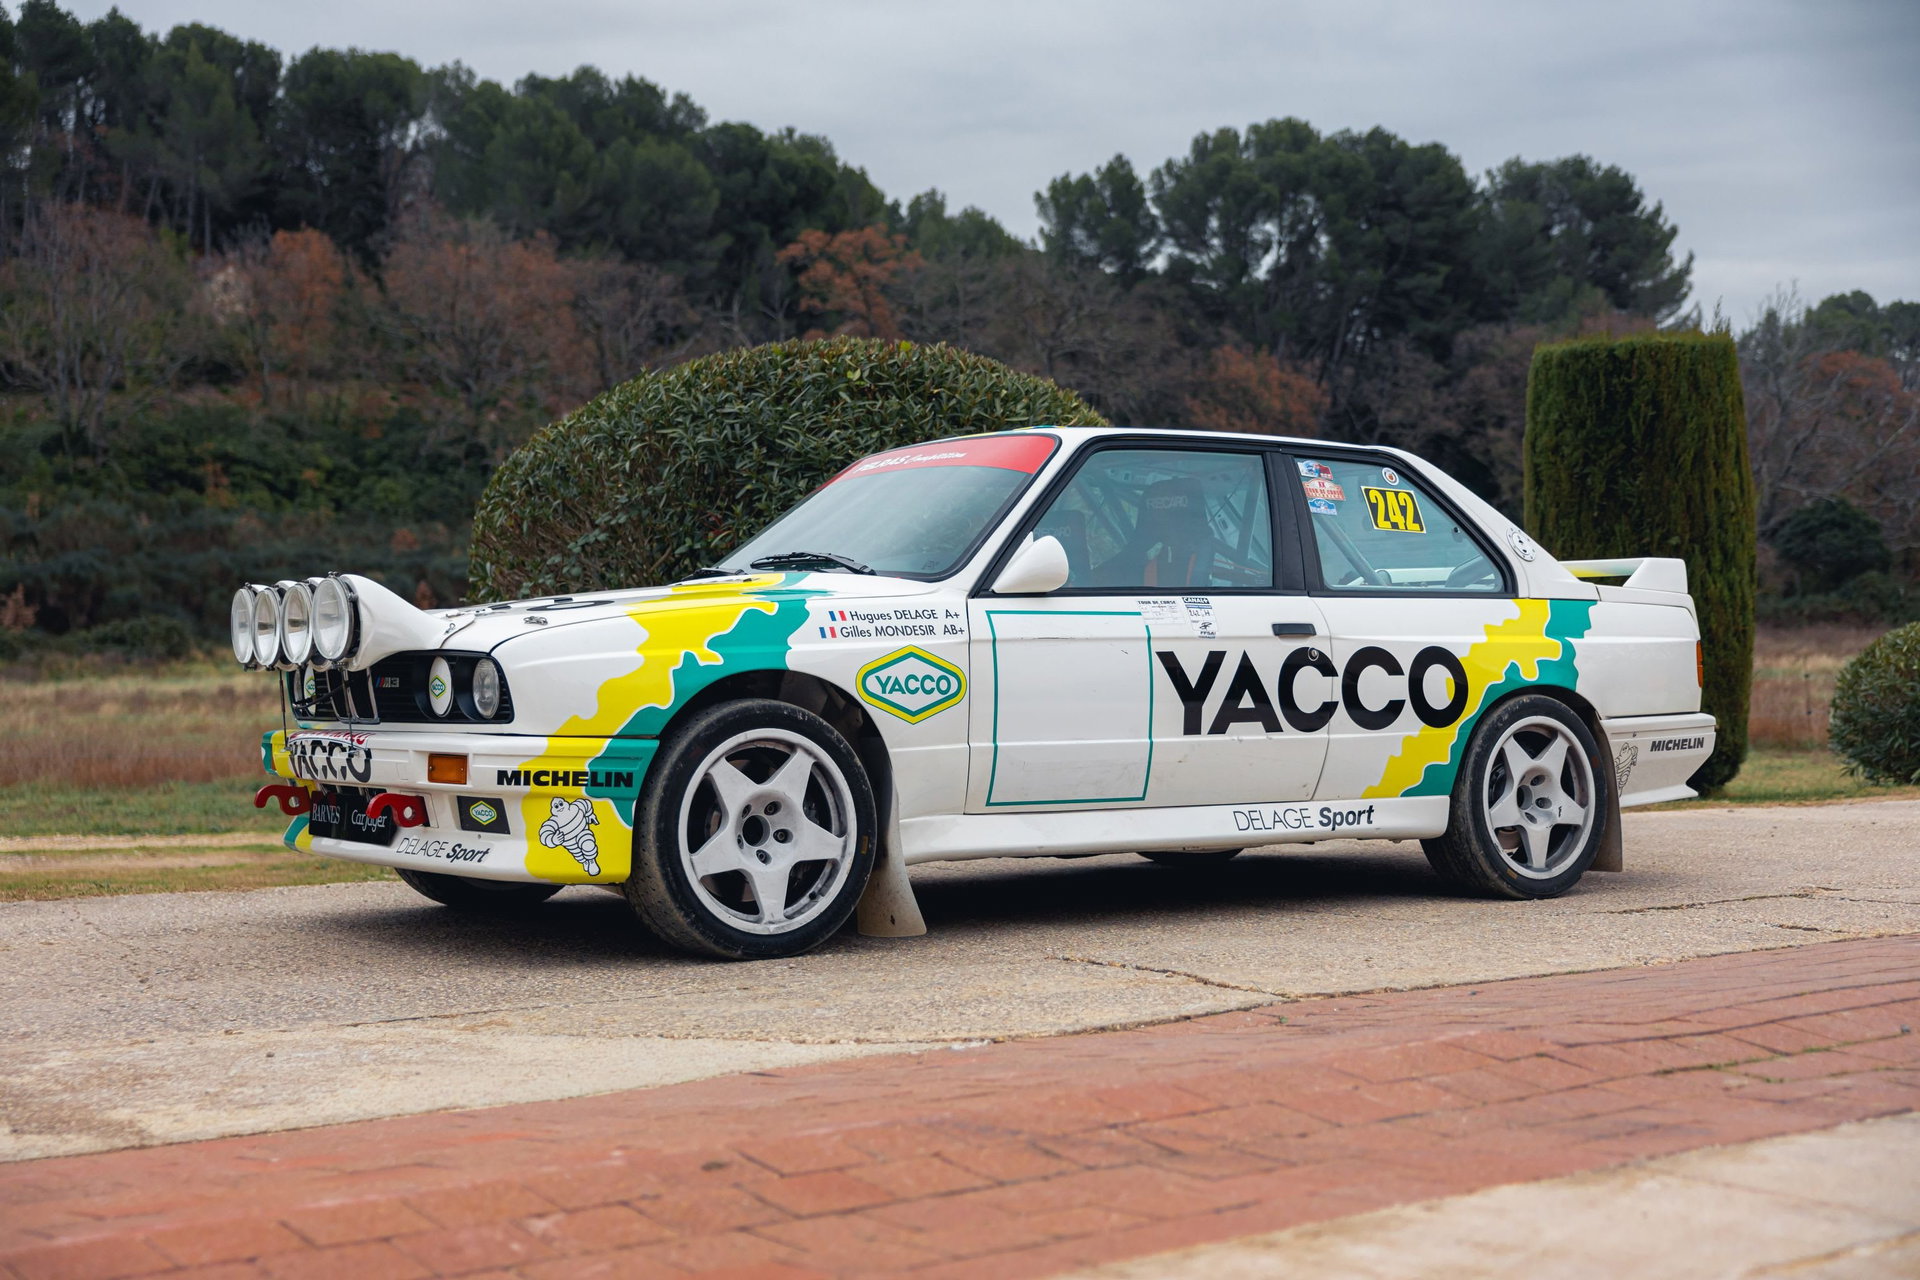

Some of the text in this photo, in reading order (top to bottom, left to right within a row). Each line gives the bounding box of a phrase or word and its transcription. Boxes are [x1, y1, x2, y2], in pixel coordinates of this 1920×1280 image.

[1145, 495, 1188, 510] RECARO
[1368, 489, 1421, 531] 242
[849, 609, 960, 623] Hugues DELAGE A+
[840, 624, 965, 638] Gilles MONDESIR AB+
[874, 674, 952, 695] YACCO
[1155, 645, 1469, 736] YACCO
[1649, 737, 1705, 752] MICHELIN
[497, 769, 634, 788] MICHELIN
[312, 803, 341, 825] BARNES
[473, 808, 493, 817] YACCO
[1233, 804, 1375, 832] DELAGE Sport
[396, 837, 491, 863] DELAGE Sport
